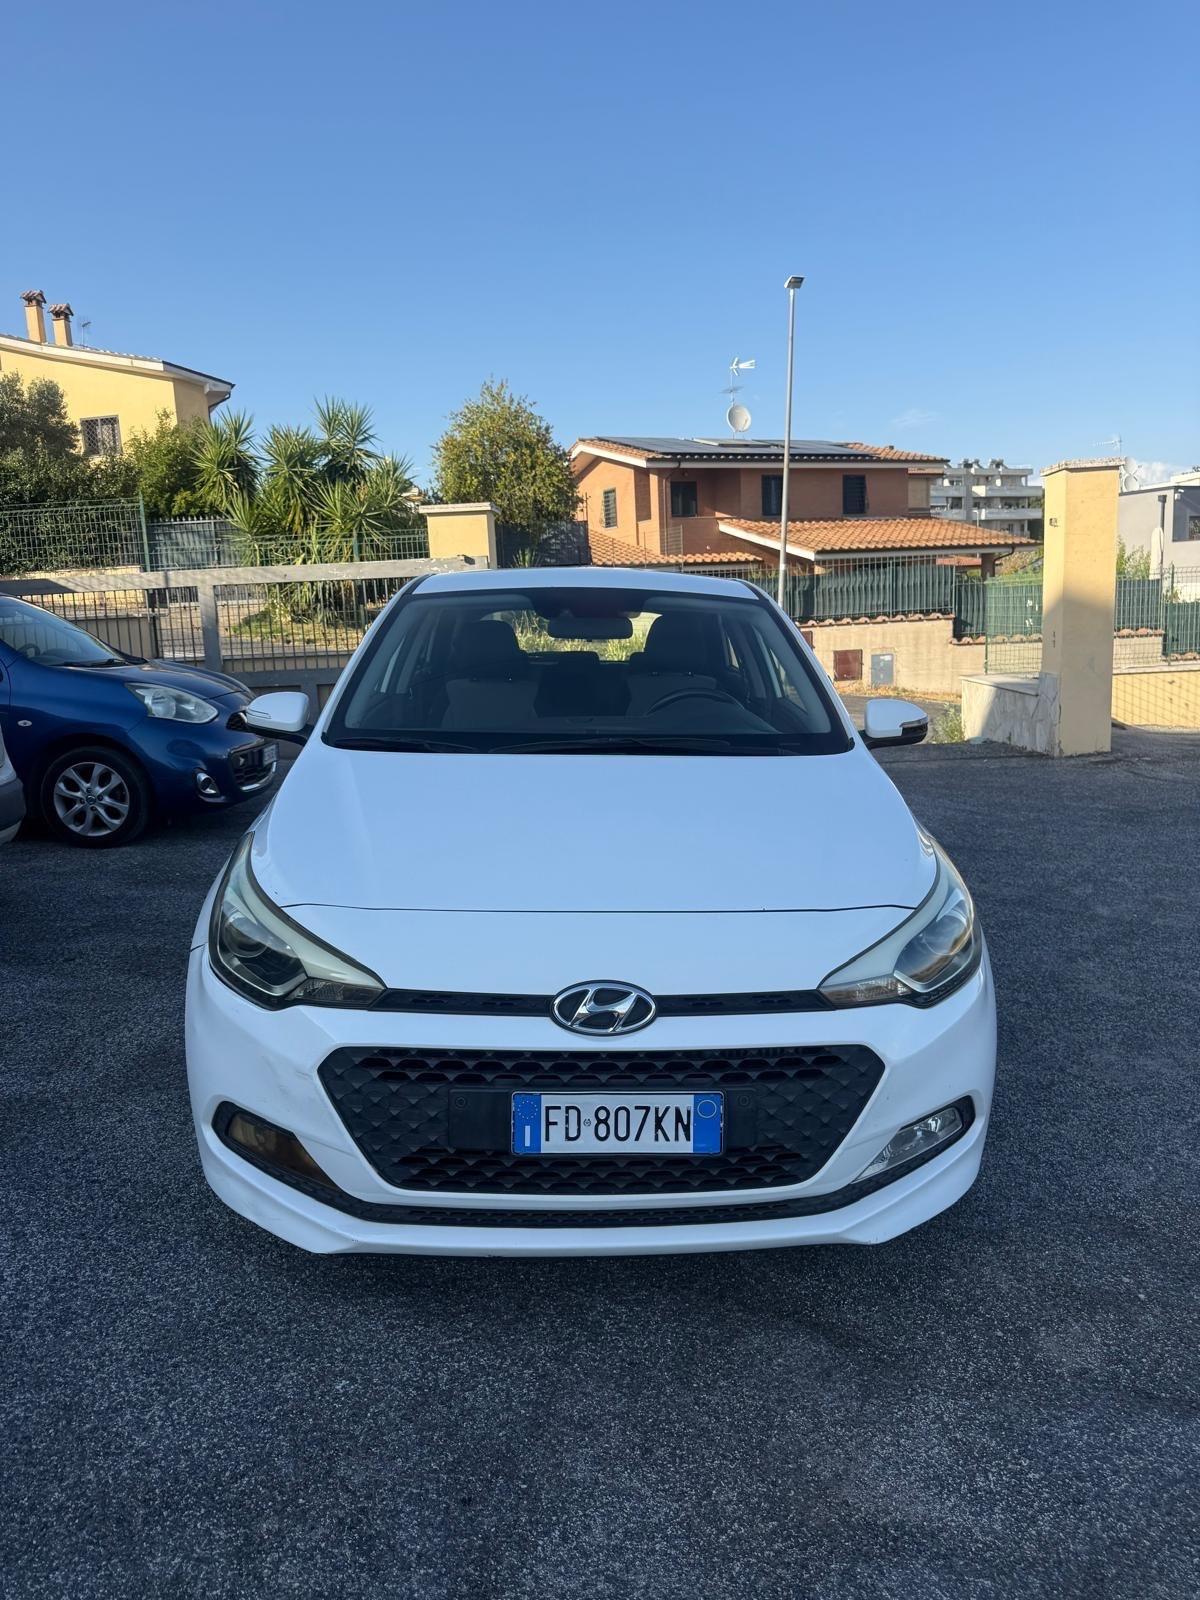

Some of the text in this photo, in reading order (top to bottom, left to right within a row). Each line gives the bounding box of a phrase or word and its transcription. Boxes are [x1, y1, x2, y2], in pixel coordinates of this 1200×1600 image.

[524, 1125, 531, 1147] I
[544, 1105, 691, 1142] FD 807KN
